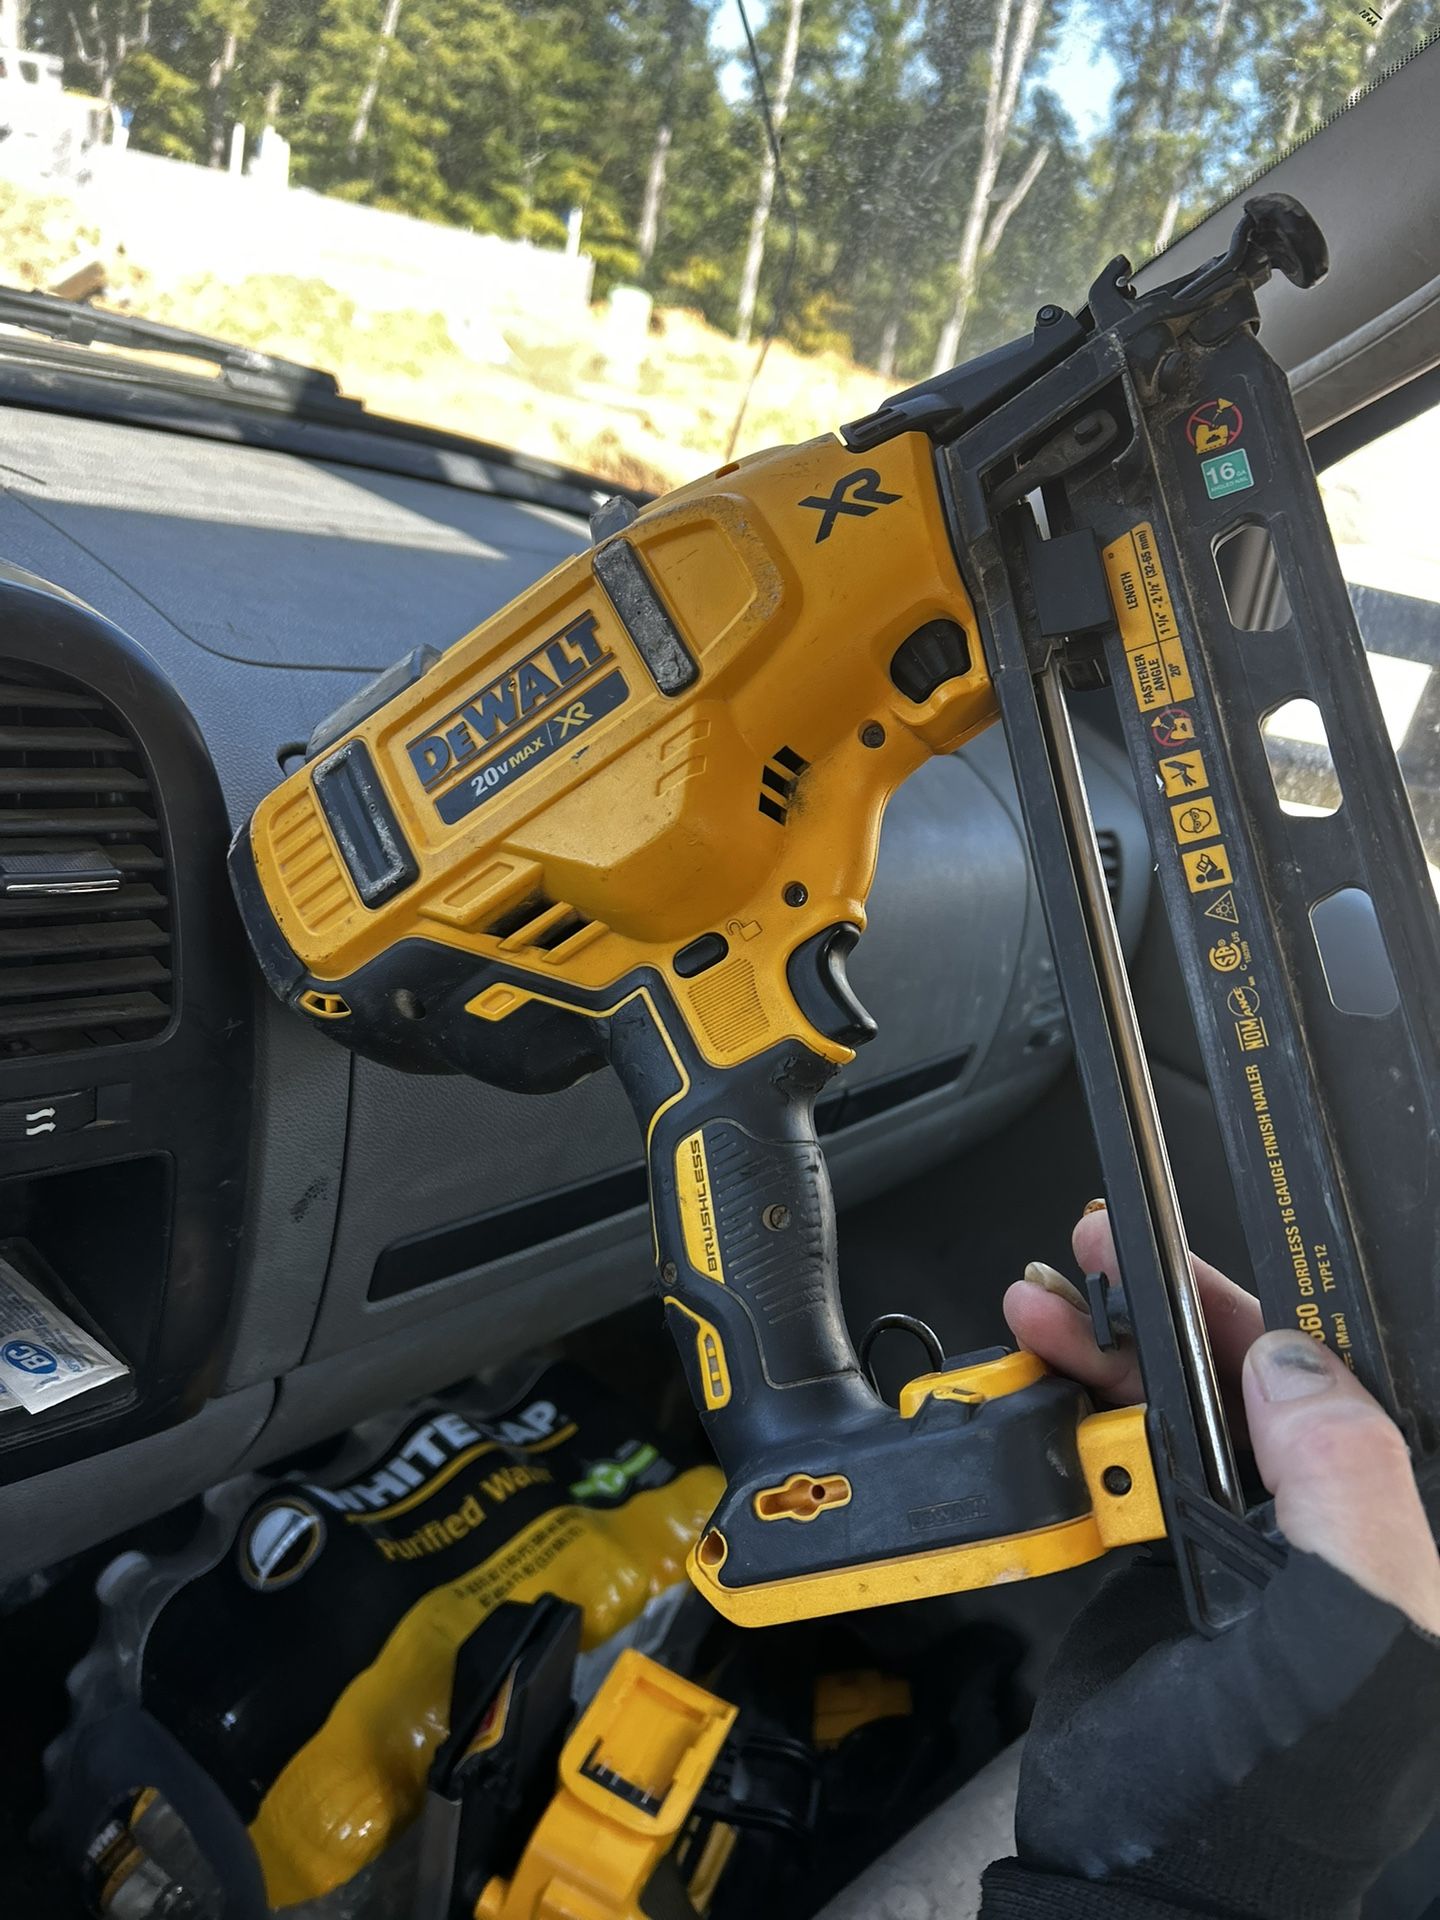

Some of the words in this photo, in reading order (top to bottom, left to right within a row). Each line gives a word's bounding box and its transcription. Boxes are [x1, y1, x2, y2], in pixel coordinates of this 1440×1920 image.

[1206, 462, 1236, 485] 16
[798, 468, 903, 544] XR
[1120, 571, 1139, 610] LENGTH
[1134, 654, 1155, 705] FASTENER
[1148, 658, 1167, 691] ANGLE
[408, 614, 606, 788] DEWALT
[553, 701, 594, 739] XR
[508, 736, 546, 769] MAX
[1232, 986, 1255, 1017] ANCE
[1239, 1018, 1265, 1051] NOM
[1245, 1064, 1269, 1112] NAILER
[1257, 1113, 1280, 1158] FINISH
[1268, 1159, 1292, 1206] GAUGE
[690, 1139, 717, 1272] BRUSHLESS
[1281, 1208, 1296, 1224] 16
[1285, 1225, 1315, 1296] CORDLESS
[1314, 1243, 1328, 1258] 12
[1317, 1259, 1336, 1293] TYPE
[1330, 1312, 1352, 1348] (Max)
[7, 1345, 53, 1371] BC
[500, 1401, 558, 1445] AP
[376, 1495, 486, 1562] Purified
